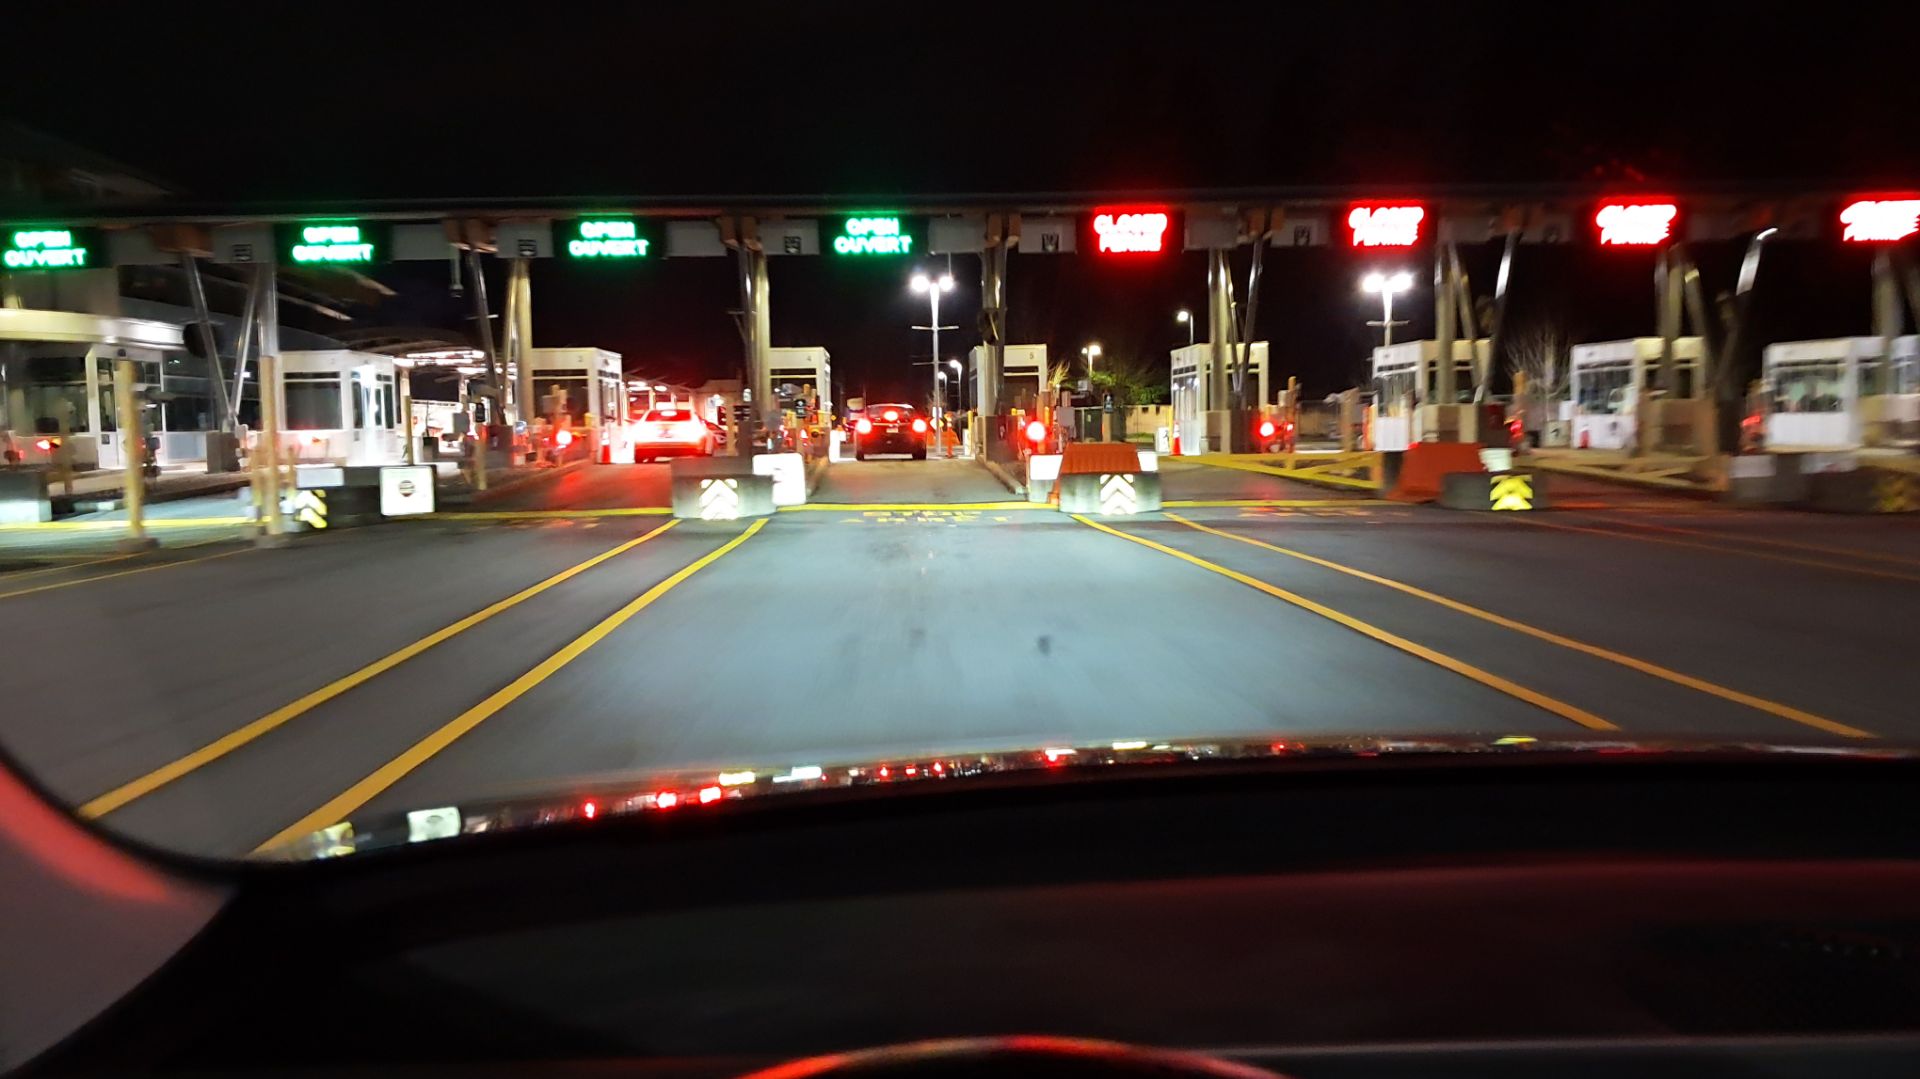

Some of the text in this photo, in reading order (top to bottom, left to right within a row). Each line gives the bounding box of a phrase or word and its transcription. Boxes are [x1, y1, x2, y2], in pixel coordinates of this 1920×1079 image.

[303, 226, 359, 243] OPEN
[580, 221, 635, 239] OPEN
[845, 217, 899, 235] OPEN
[15, 230, 71, 248] OPEN
[568, 239, 649, 256] OUVERT
[834, 235, 912, 253] OUVERT
[4, 248, 87, 266] OUVERT
[292, 244, 374, 261] OUVERT
